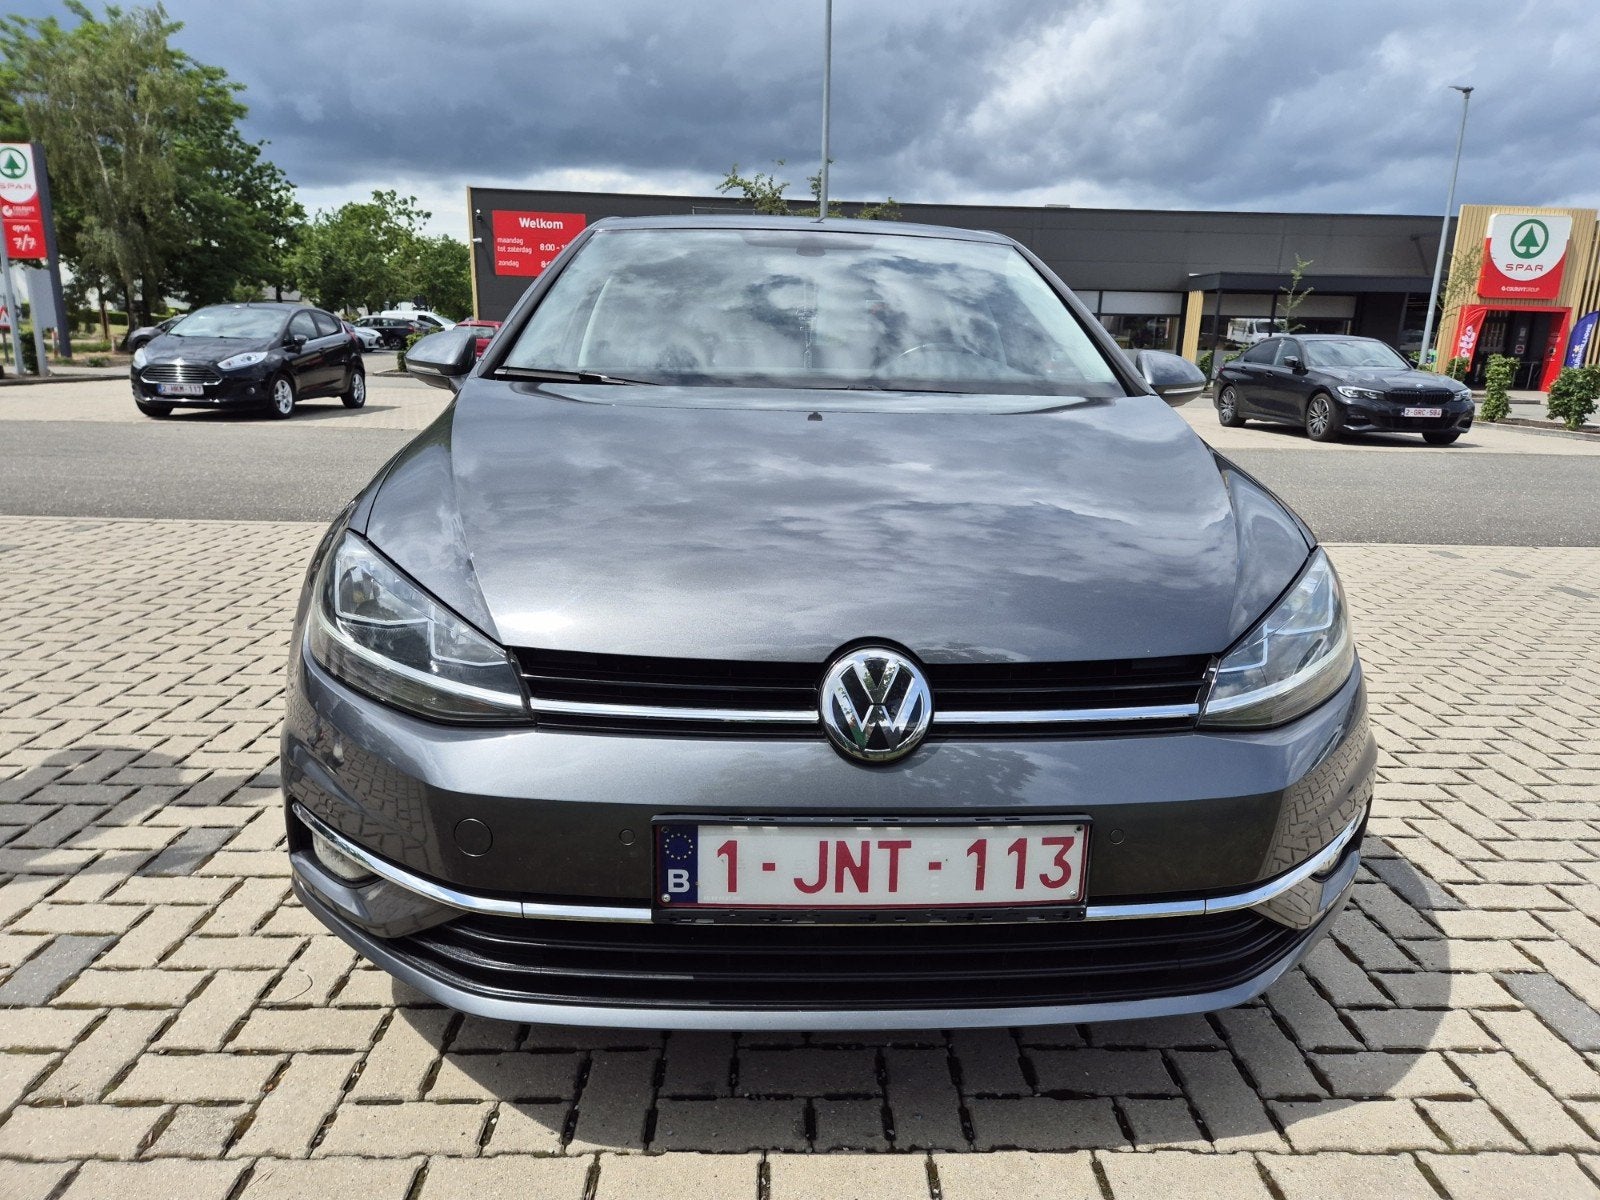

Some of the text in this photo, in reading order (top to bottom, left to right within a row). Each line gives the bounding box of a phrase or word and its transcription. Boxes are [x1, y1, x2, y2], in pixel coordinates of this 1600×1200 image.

[519, 217, 564, 230] Welkom
[12, 234, 36, 252] 7/7
[497, 237, 524, 245] maandag
[497, 245, 533, 255] tot zaterdag
[539, 243, 556, 252] 8:00
[498, 260, 520, 268] zondag
[1505, 263, 1544, 272] SPAR
[716, 836, 1076, 894] 1-JNT-113
[667, 868, 691, 893] B
